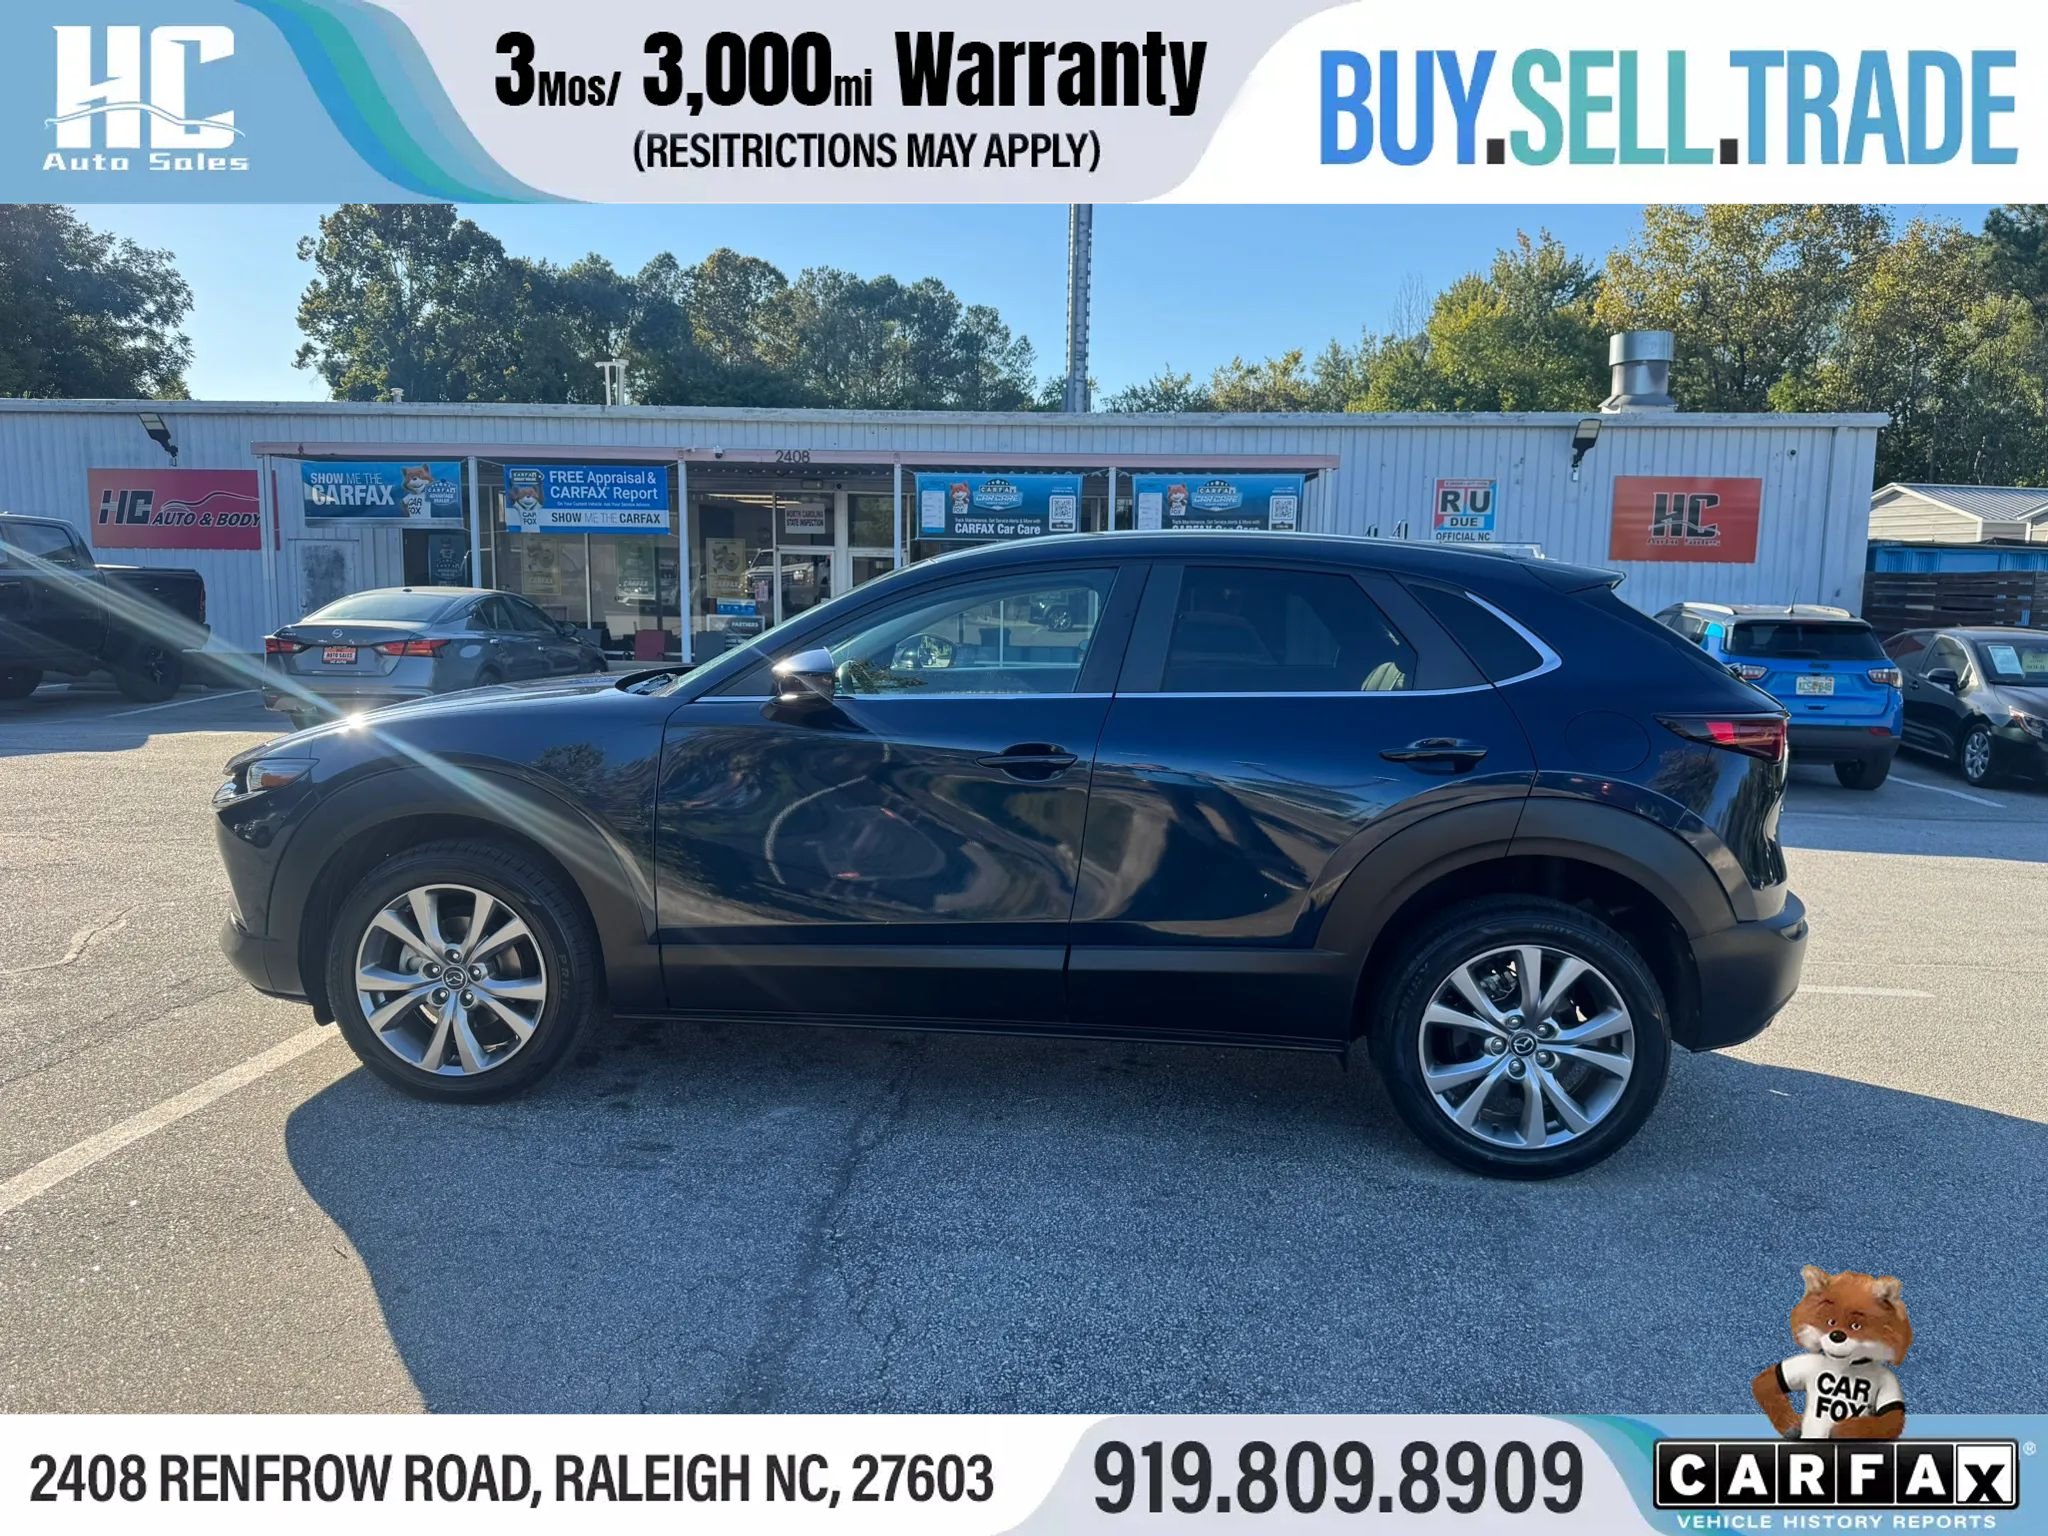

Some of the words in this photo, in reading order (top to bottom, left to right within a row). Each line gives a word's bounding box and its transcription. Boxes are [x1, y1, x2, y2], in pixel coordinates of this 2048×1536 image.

[775, 449, 811, 464] 2408
[310, 473, 344, 485] SHOW
[346, 473, 361, 485] ME
[364, 473, 384, 485] THE
[550, 471, 584, 484] FREE
[587, 471, 645, 487] Appraisal
[647, 473, 657, 485] &
[311, 485, 395, 506] CARFAX
[613, 488, 659, 502] Report
[98, 490, 155, 526] HC
[1651, 491, 1721, 538] HC
[152, 511, 195, 528] AUTO
[199, 511, 213, 527] &
[216, 511, 261, 528] BODY
[552, 512, 581, 523] SHOW
[584, 512, 598, 524] ME
[601, 513, 617, 524] THE
[619, 512, 661, 525] CARFAX
[1450, 517, 1478, 527] DUE
[955, 523, 995, 535] CARFAX
[997, 523, 1014, 535] Car
[1018, 523, 1041, 535] Care
[1435, 532, 1475, 541] OFFICIAL
[1478, 532, 1491, 541] NC
